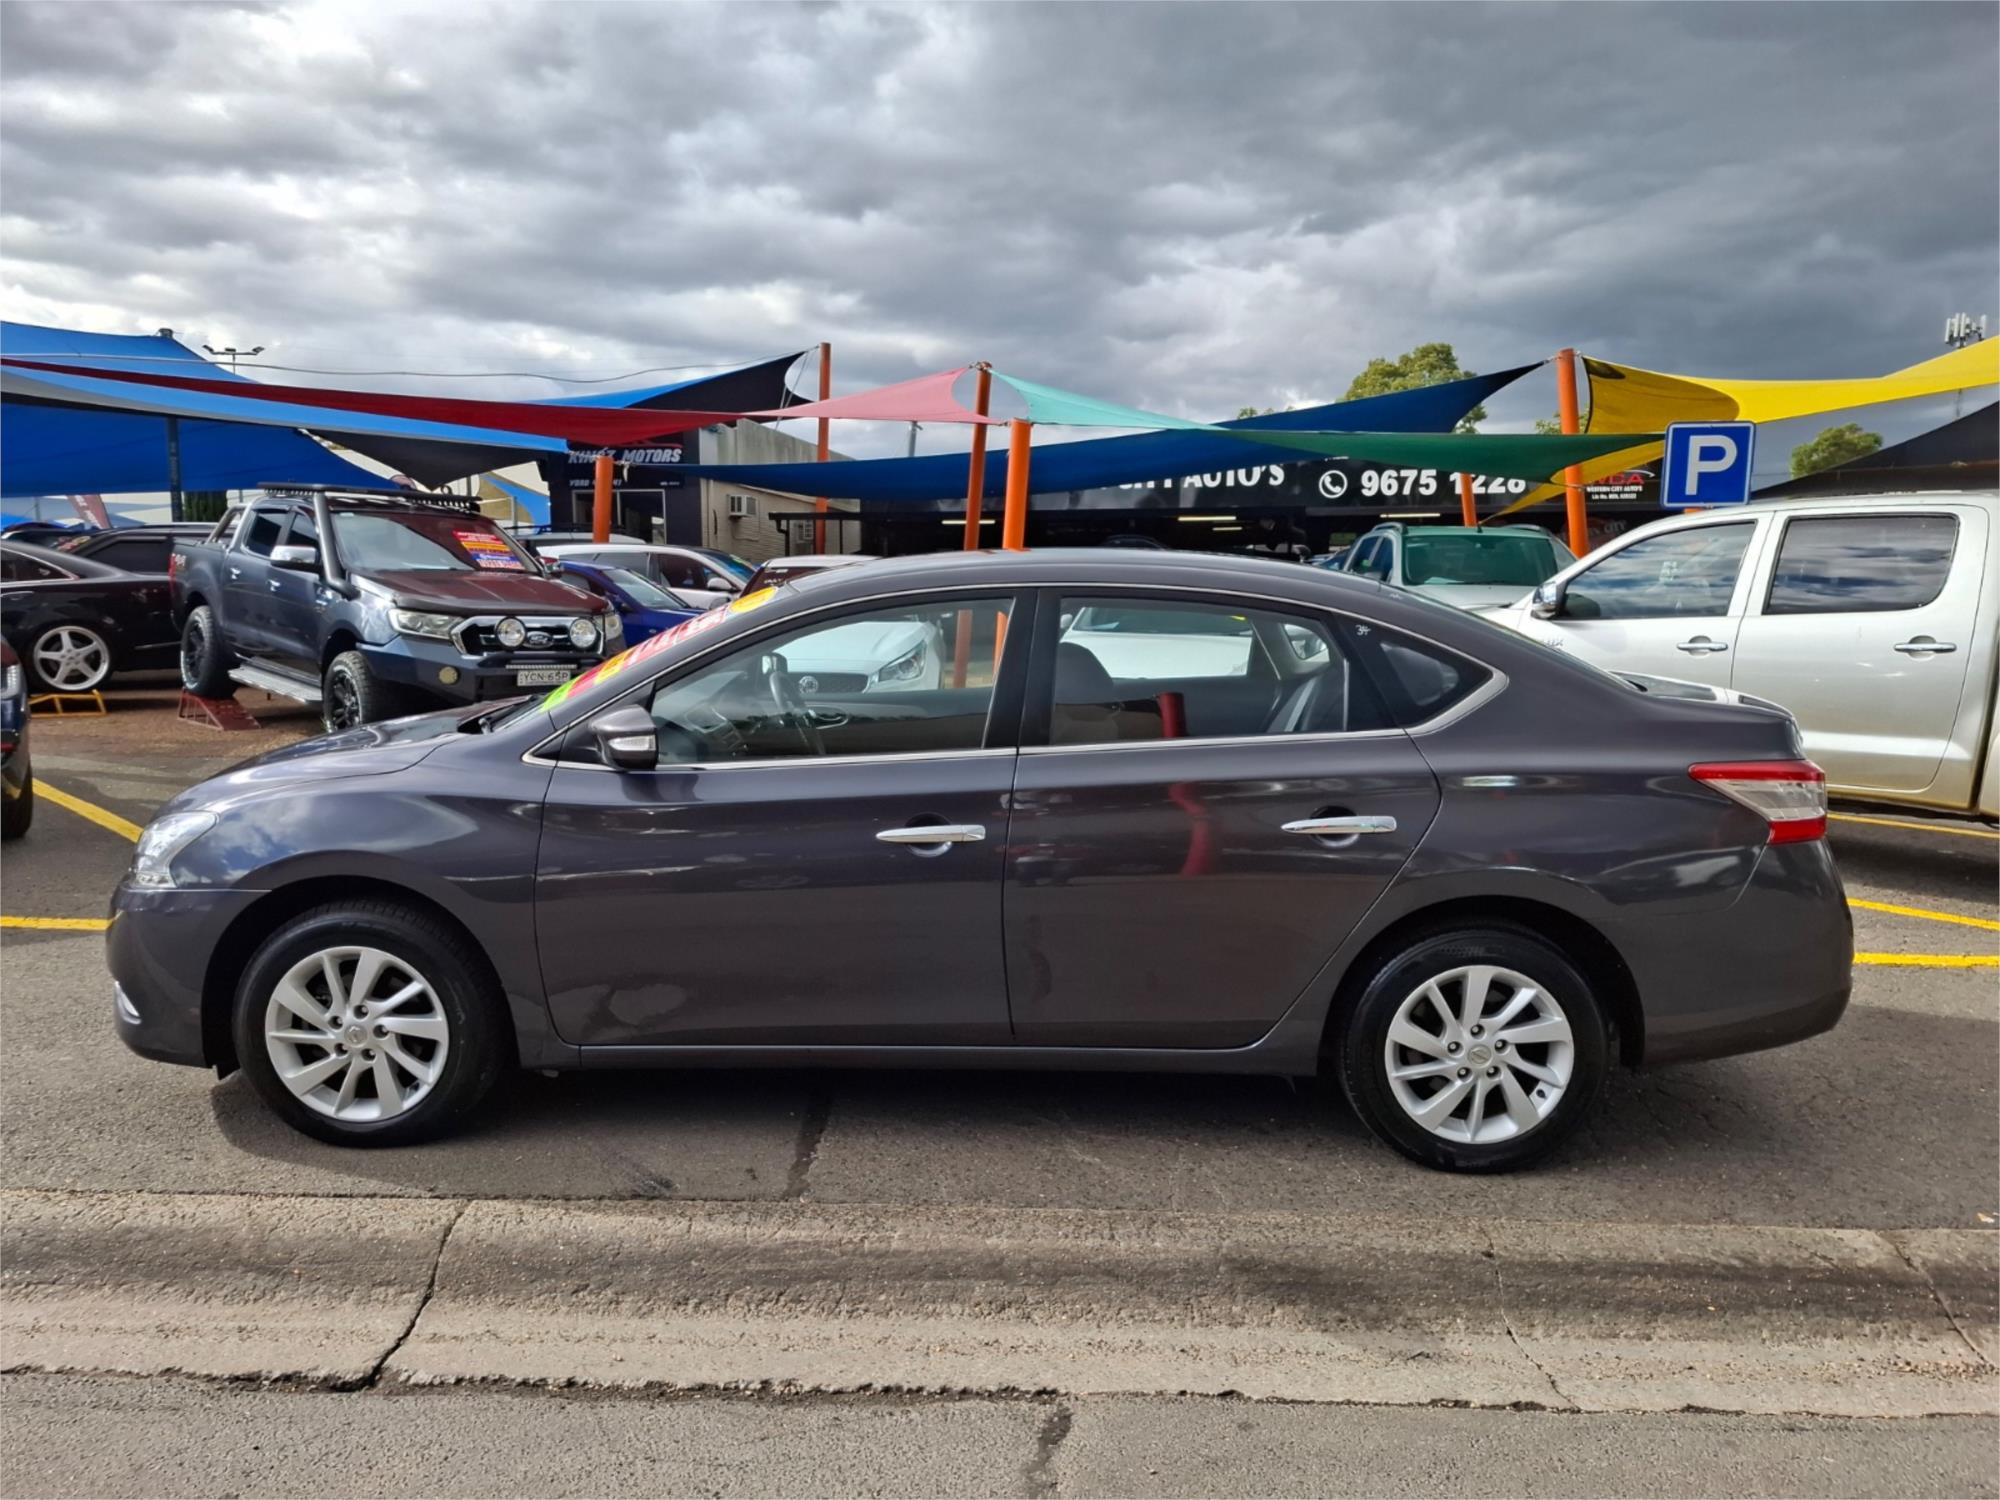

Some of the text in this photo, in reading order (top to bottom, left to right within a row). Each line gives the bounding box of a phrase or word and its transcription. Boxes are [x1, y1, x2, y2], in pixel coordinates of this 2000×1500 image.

[622, 448, 682, 463] MOTORS
[1685, 434, 1737, 496] P
[1360, 469, 1438, 496] 9675
